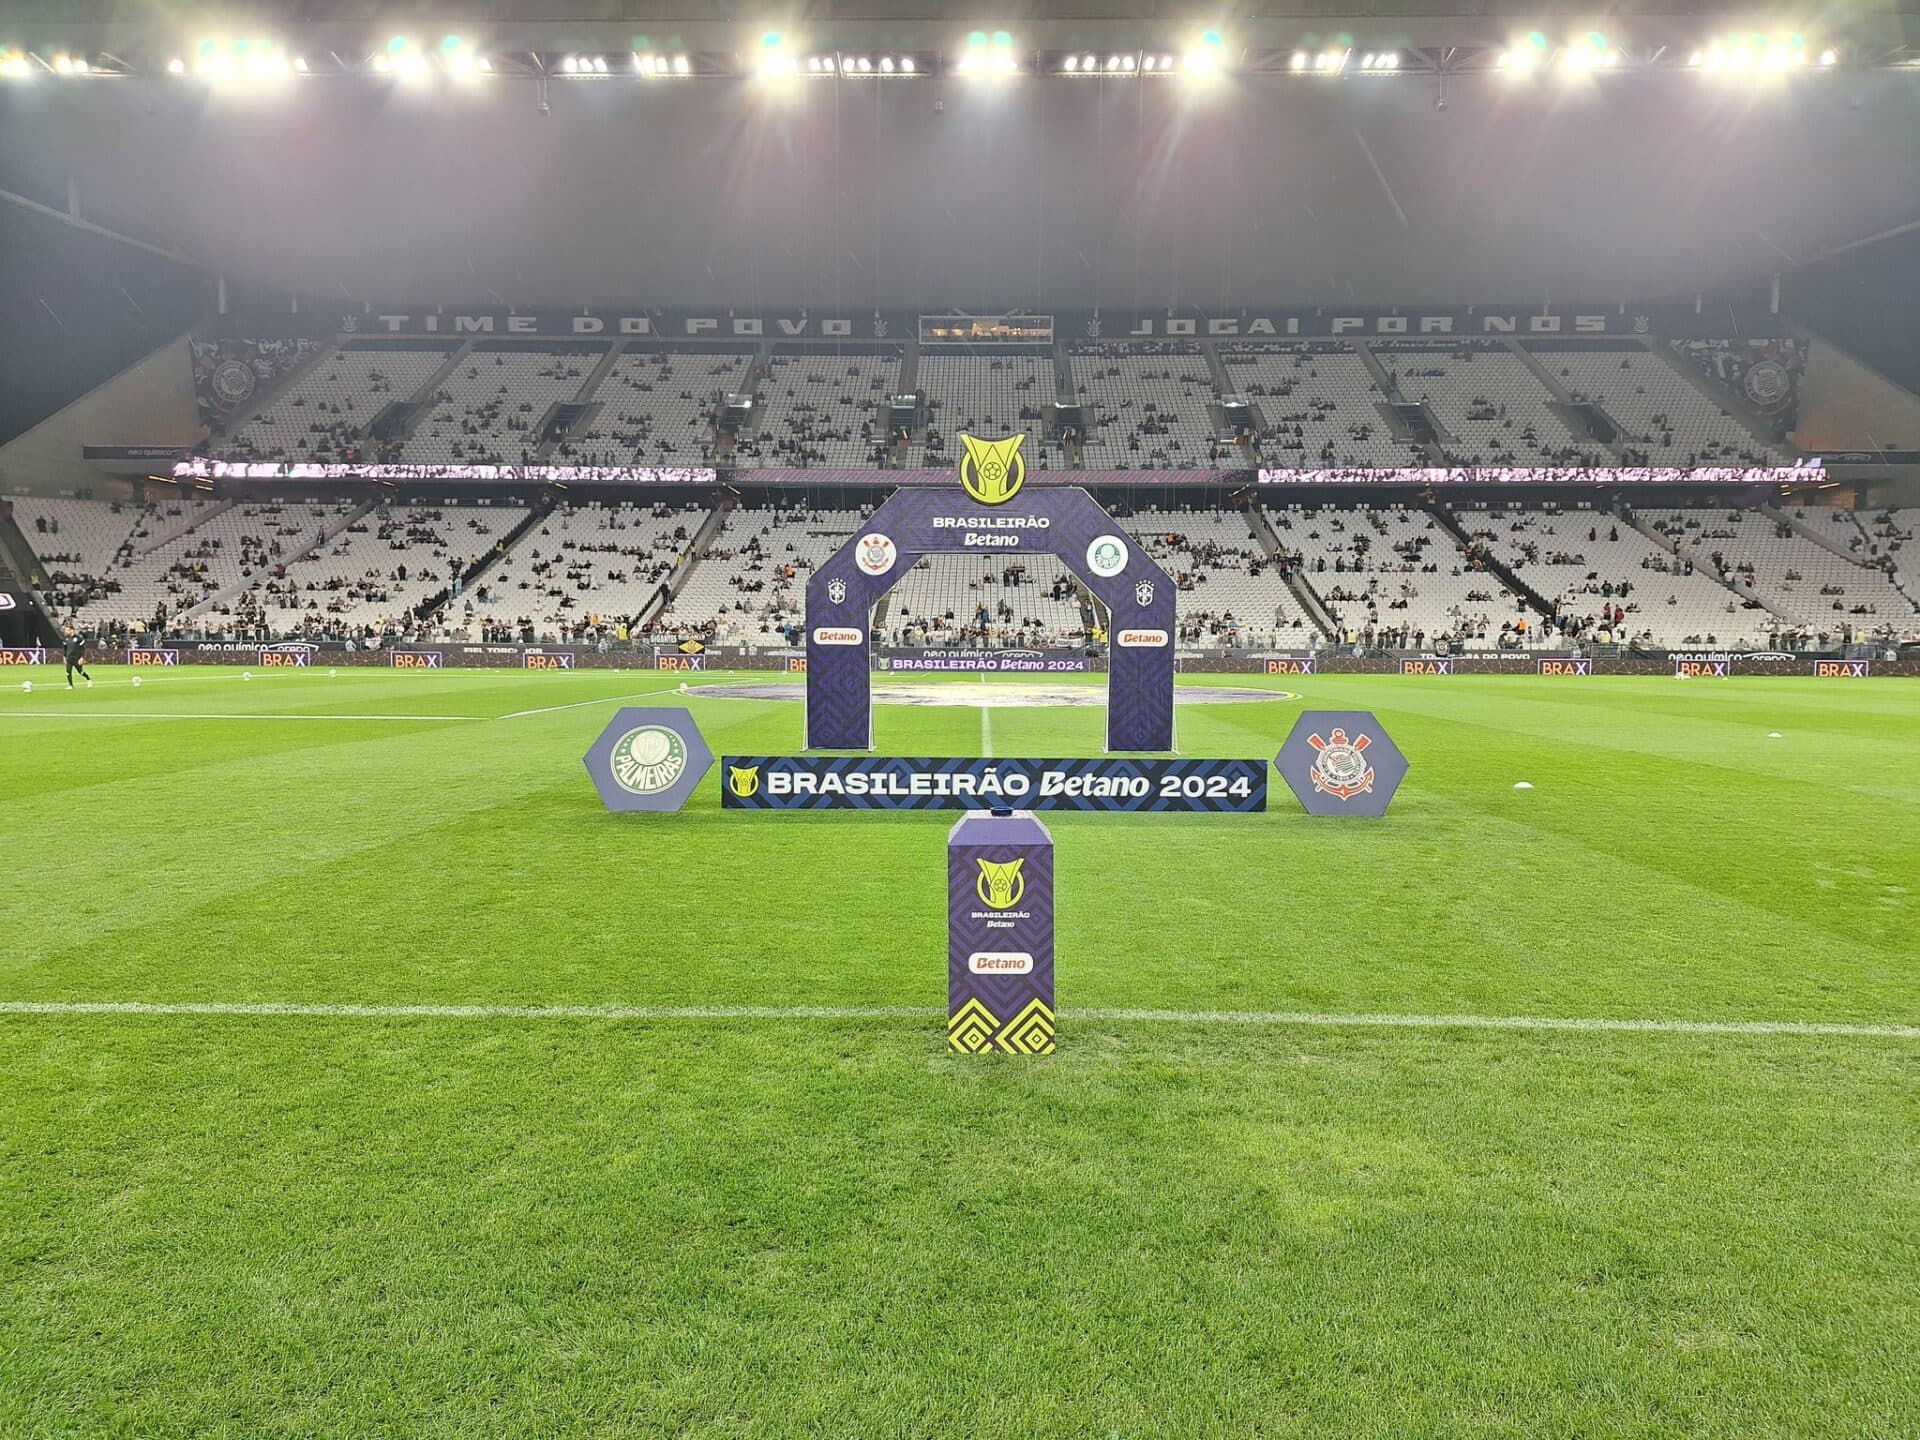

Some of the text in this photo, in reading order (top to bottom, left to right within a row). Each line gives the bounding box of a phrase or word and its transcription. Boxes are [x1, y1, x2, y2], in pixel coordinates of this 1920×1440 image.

[378, 315, 852, 336] TIME DO POVO
[1130, 318, 1299, 335] JOGAI
[1332, 316, 1453, 333] POR
[932, 514, 1050, 529] BRASILEIRÃO
[963, 532, 1019, 547] Betano
[819, 631, 857, 641] Betano
[1123, 633, 1163, 643] Betano
[0, 651, 41, 665] RAX
[132, 651, 174, 665] BRAX
[263, 653, 306, 667] BRAX
[395, 654, 438, 668] BRAX
[527, 655, 570, 669] BRAX
[659, 657, 701, 671] BRAX
[789, 658, 807, 672] BR
[893, 657, 1085, 671] BRASILEIRÃO Betano 2024
[1268, 660, 1312, 674] BRAX
[1404, 661, 1448, 675] BRAX
[1542, 662, 1587, 676] BRAX
[1681, 662, 1725, 677] BRAX
[1819, 663, 1864, 677] BRAX
[615, 754, 682, 791] PALMEIRAS
[767, 767, 1251, 798] BRASILEIRÃO Betano 2024
[971, 910, 1031, 920] BRASILEIRÃO
[986, 920, 1015, 929] Betano
[976, 957, 1026, 970] Betano
